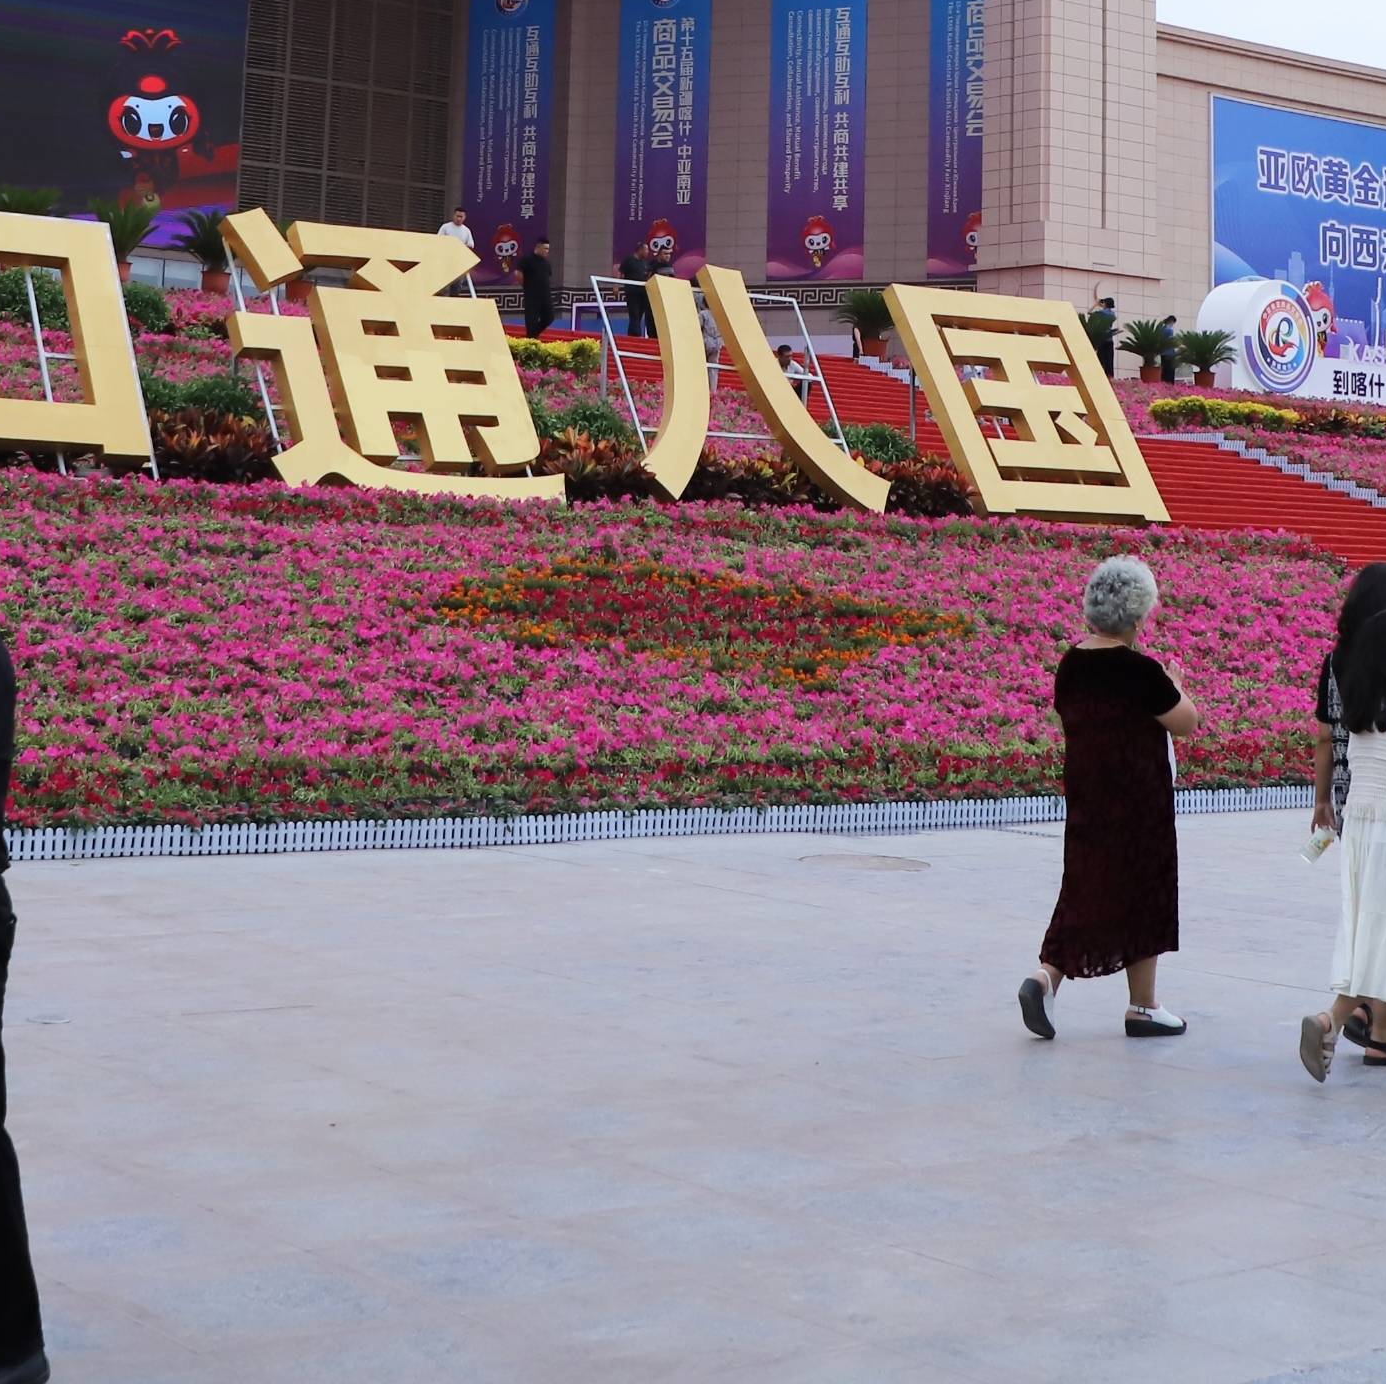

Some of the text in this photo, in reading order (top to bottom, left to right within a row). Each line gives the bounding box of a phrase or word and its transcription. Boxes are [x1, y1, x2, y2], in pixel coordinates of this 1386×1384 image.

[520, 25, 540, 220] 互通互助互利 共商共建共享
[650, 18, 677, 149] 商品交易会
[832, 6, 851, 212] 互通互助互利 共商共建共享
